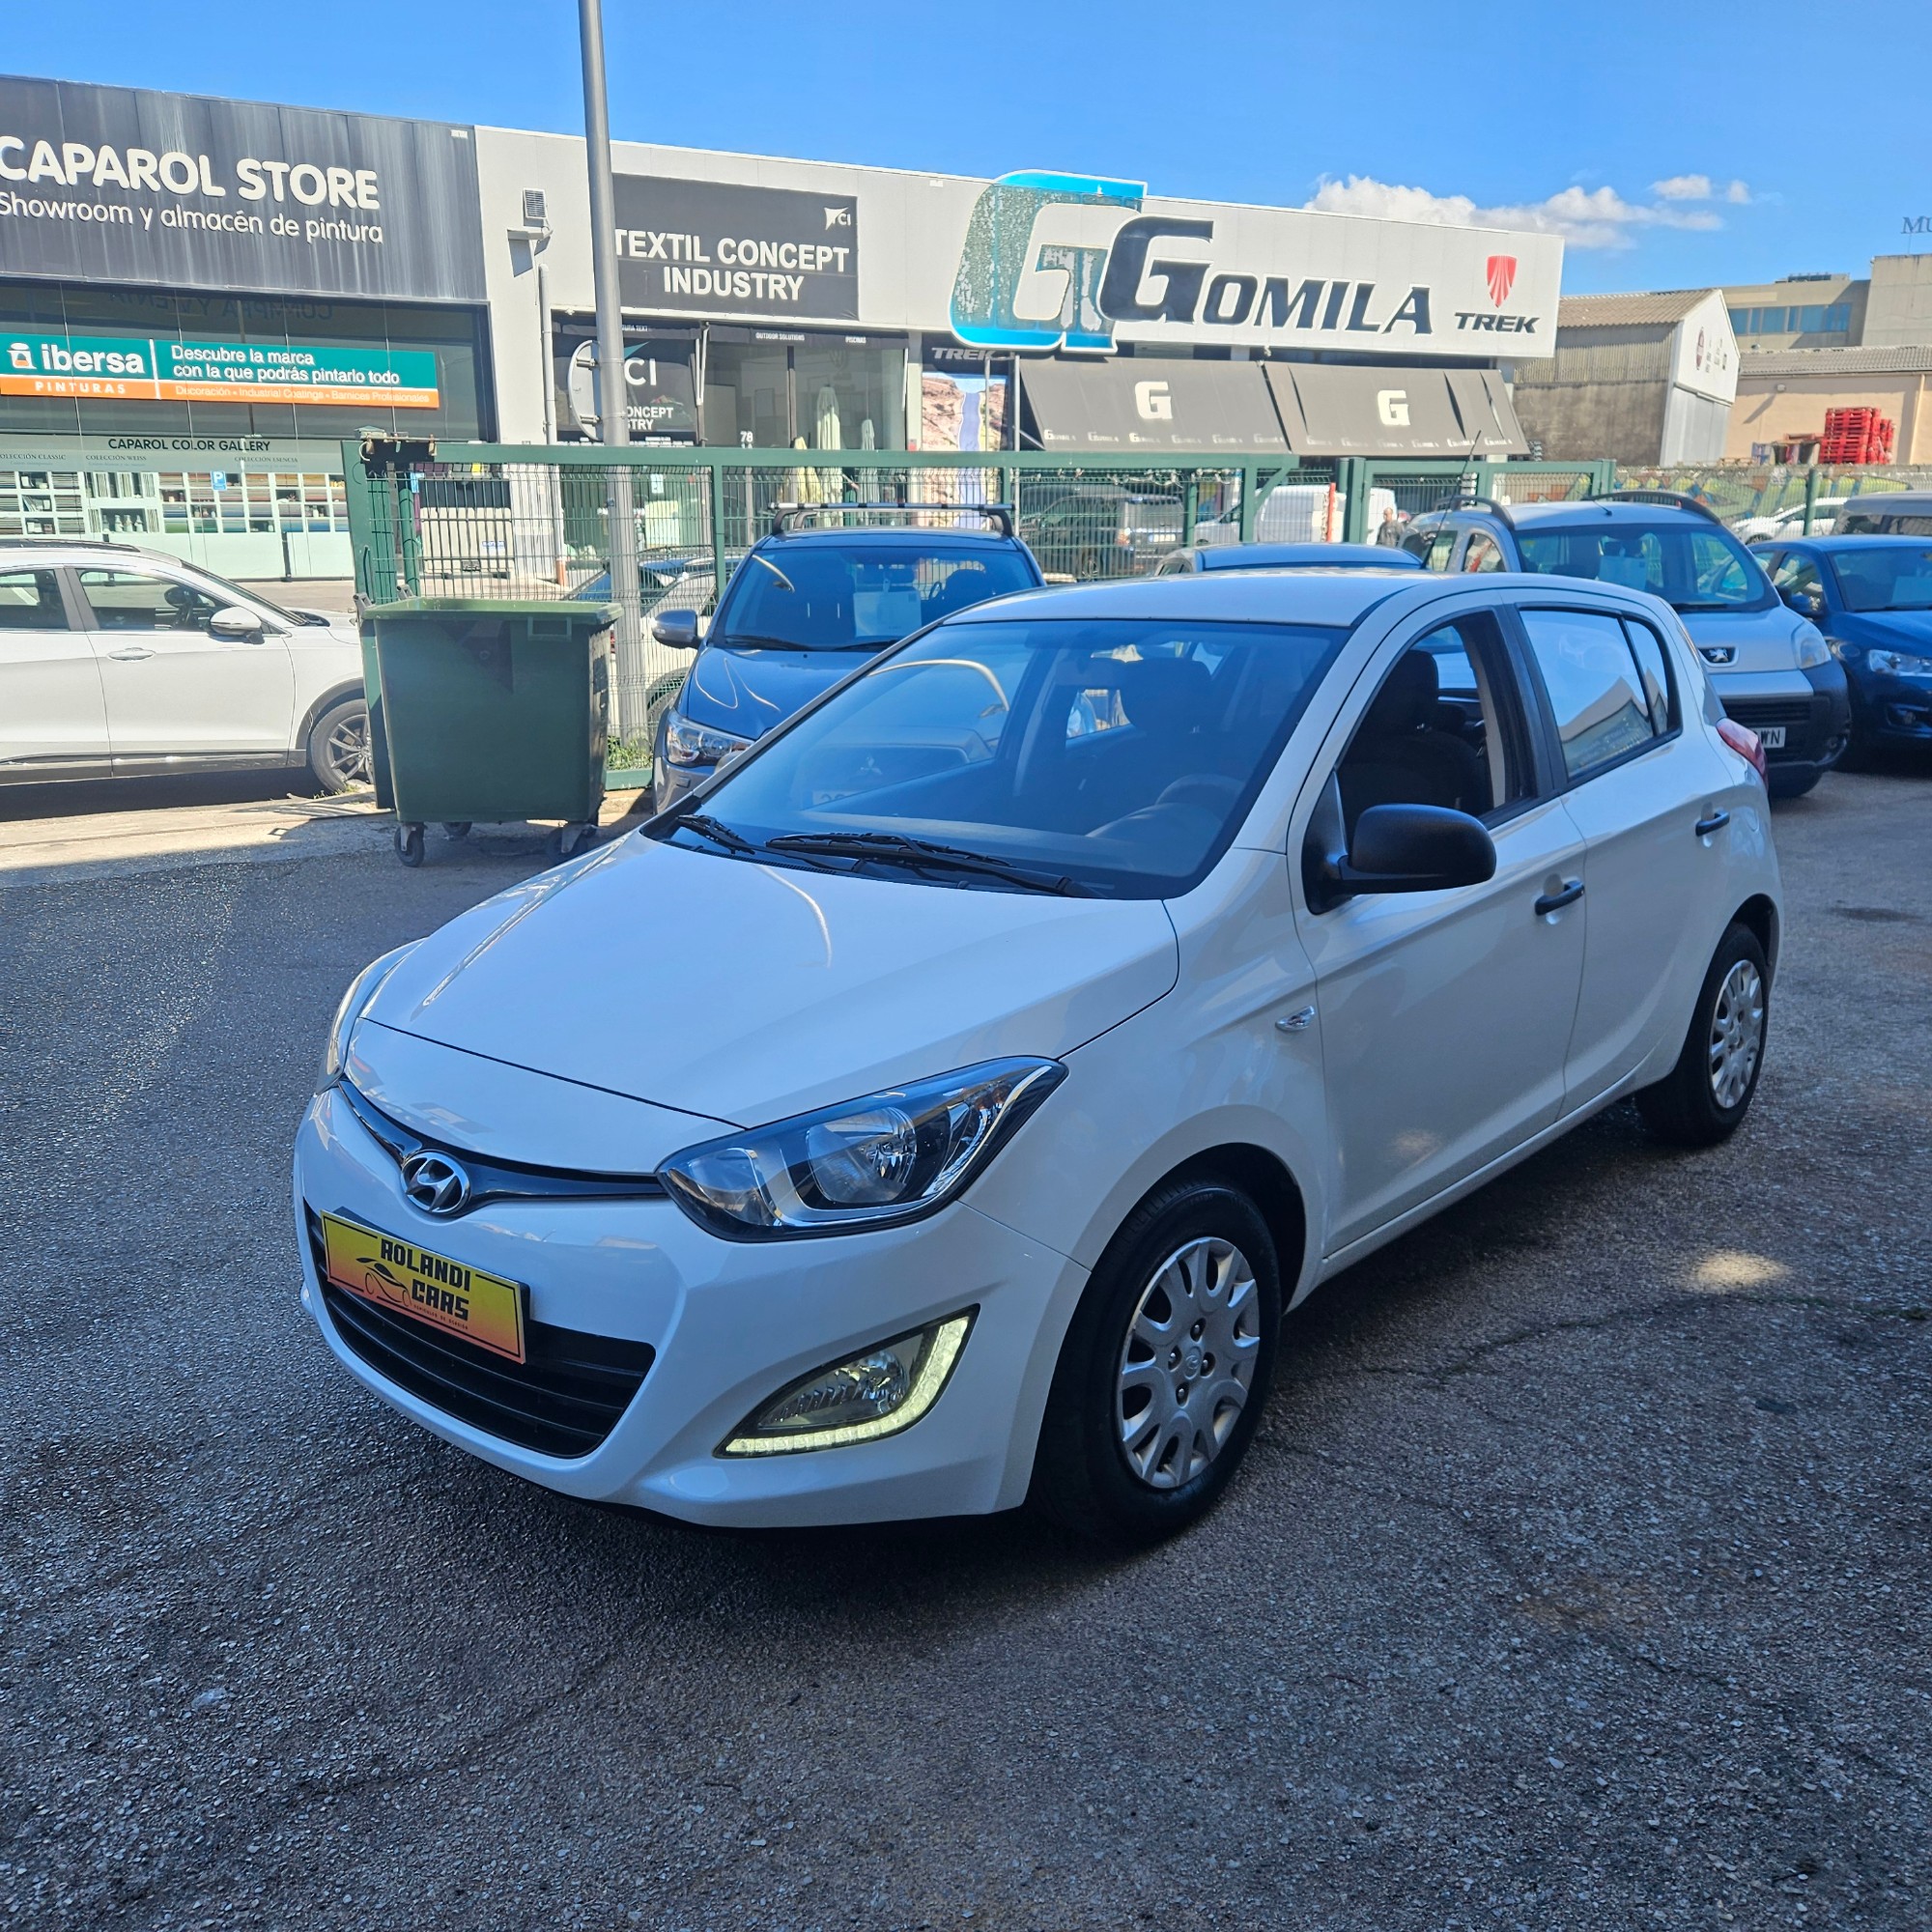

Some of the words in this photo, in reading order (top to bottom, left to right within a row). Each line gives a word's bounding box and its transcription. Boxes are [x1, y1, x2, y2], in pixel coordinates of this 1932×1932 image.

[0, 135, 226, 197] CAPAROL
[237, 157, 381, 210] STORE
[0, 191, 133, 225] Showroom
[139, 206, 153, 231] y
[160, 204, 263, 235] almacén
[270, 213, 300, 237] de
[305, 216, 384, 244] pintura
[614, 228, 711, 263] TEXTIL
[717, 238, 850, 272] CONCEPT
[664, 267, 805, 300] INDUSTRY
[1099, 214, 1435, 336] GOMILA
[1455, 311, 1542, 334] TREK
[41, 343, 145, 374] ibersa
[171, 345, 247, 363] Descubre
[249, 348, 266, 364] la
[268, 351, 316, 366] marca
[931, 347, 998, 361] TREK
[35, 381, 127, 394] PINTURAS
[173, 364, 203, 379] con
[206, 363, 222, 380] la
[223, 367, 254, 382] que
[257, 366, 309, 383] podrás
[312, 368, 366, 384] pintarlo
[368, 370, 401, 384] todo
[175, 385, 232, 396] Decoración
[239, 388, 281, 398] Industrial
[1134, 381, 1173, 419] G
[1377, 389, 1410, 426] G
[108, 439, 169, 450] CAPAROL
[172, 440, 215, 451] COLOR
[218, 440, 270, 451] GALLERY
[740, 431, 753, 442] 78
[381, 1237, 470, 1293] ROLANDI
[412, 1278, 469, 1321] CARS
